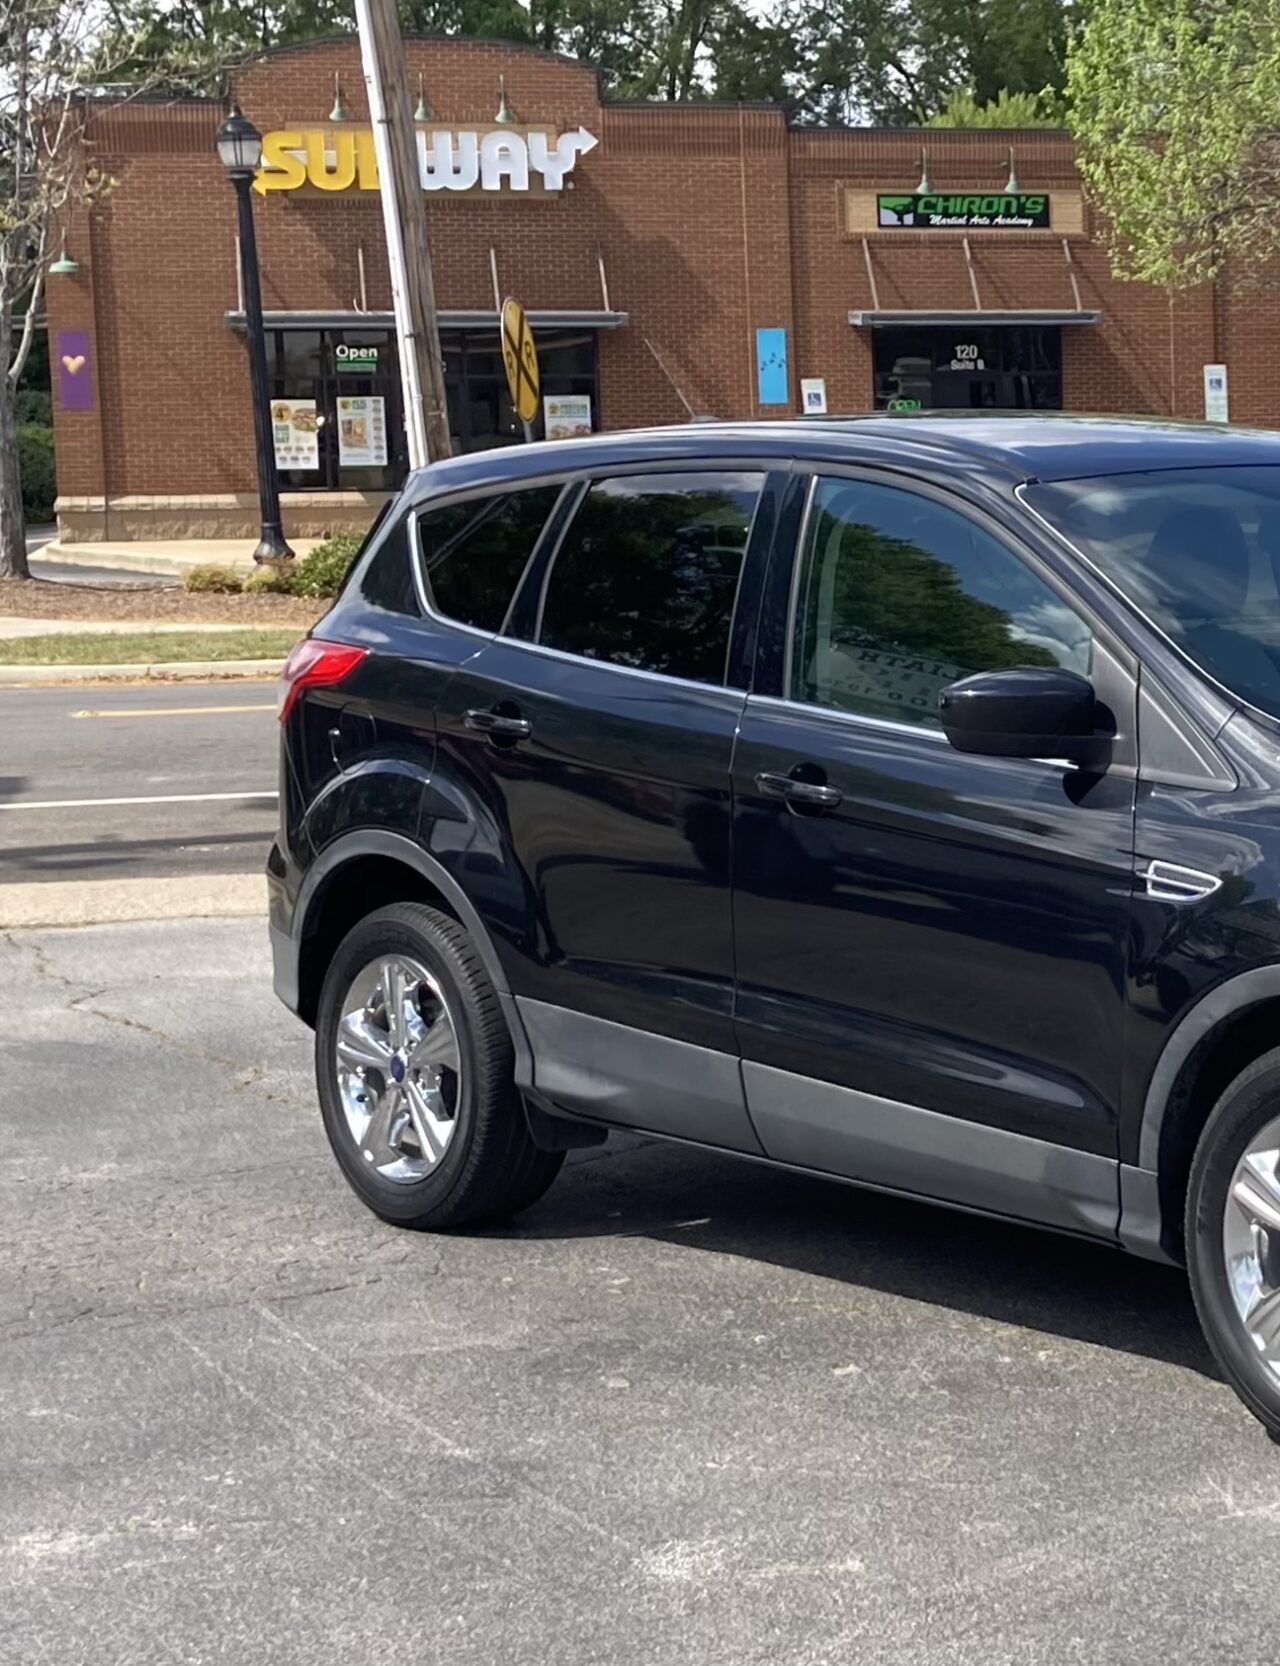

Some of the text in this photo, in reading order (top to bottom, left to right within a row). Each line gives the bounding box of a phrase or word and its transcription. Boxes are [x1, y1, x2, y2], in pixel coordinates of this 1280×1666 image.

[917, 196, 1045, 214] CHIRON'S
[929, 214, 1034, 227] Martial Arts Academy
[336, 344, 378, 361] Open
[524, 341, 535, 369] R
[954, 345, 978, 359] 120
[950, 359, 975, 370] Suite
